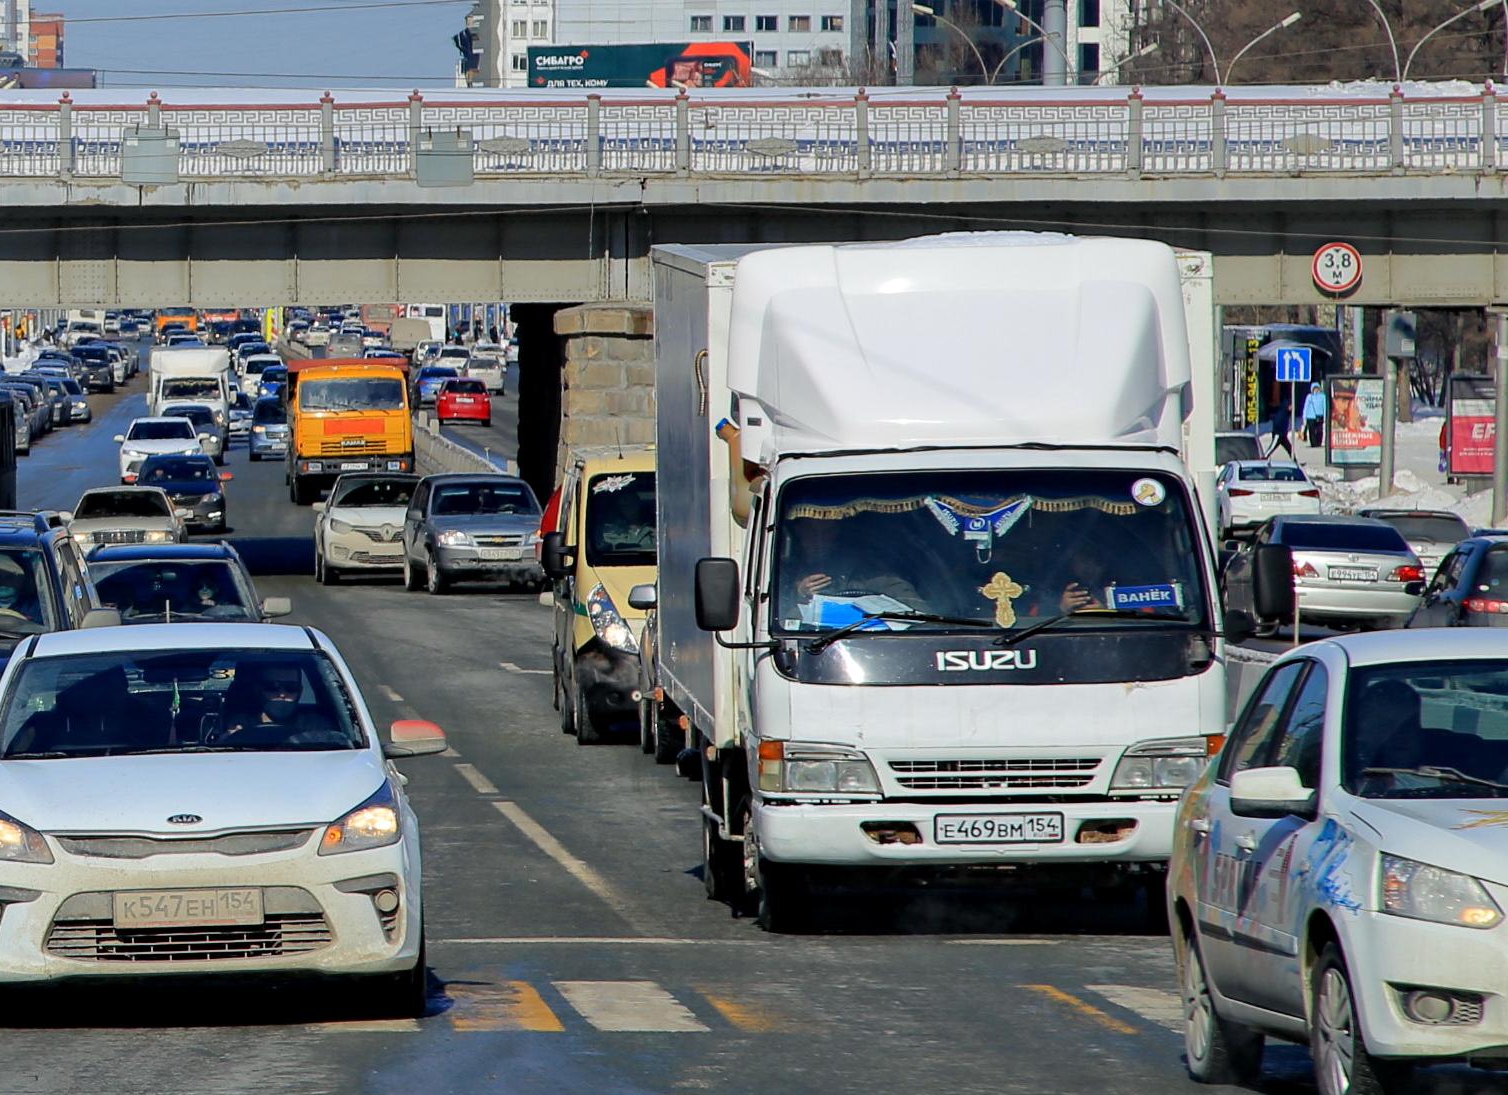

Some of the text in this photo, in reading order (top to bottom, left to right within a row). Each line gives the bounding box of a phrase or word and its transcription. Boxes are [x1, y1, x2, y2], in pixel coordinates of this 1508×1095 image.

[536, 56, 584, 66] СИБАГРО
[1325, 253, 1351, 269] 3,8
[1117, 588, 1171, 603] ВАНЁК
[936, 650, 1037, 671] ISUZU
[172, 815, 198, 823] KIA
[944, 818, 1056, 838] Е469ВМ 154
[123, 892, 255, 919] К547ЕН 154
